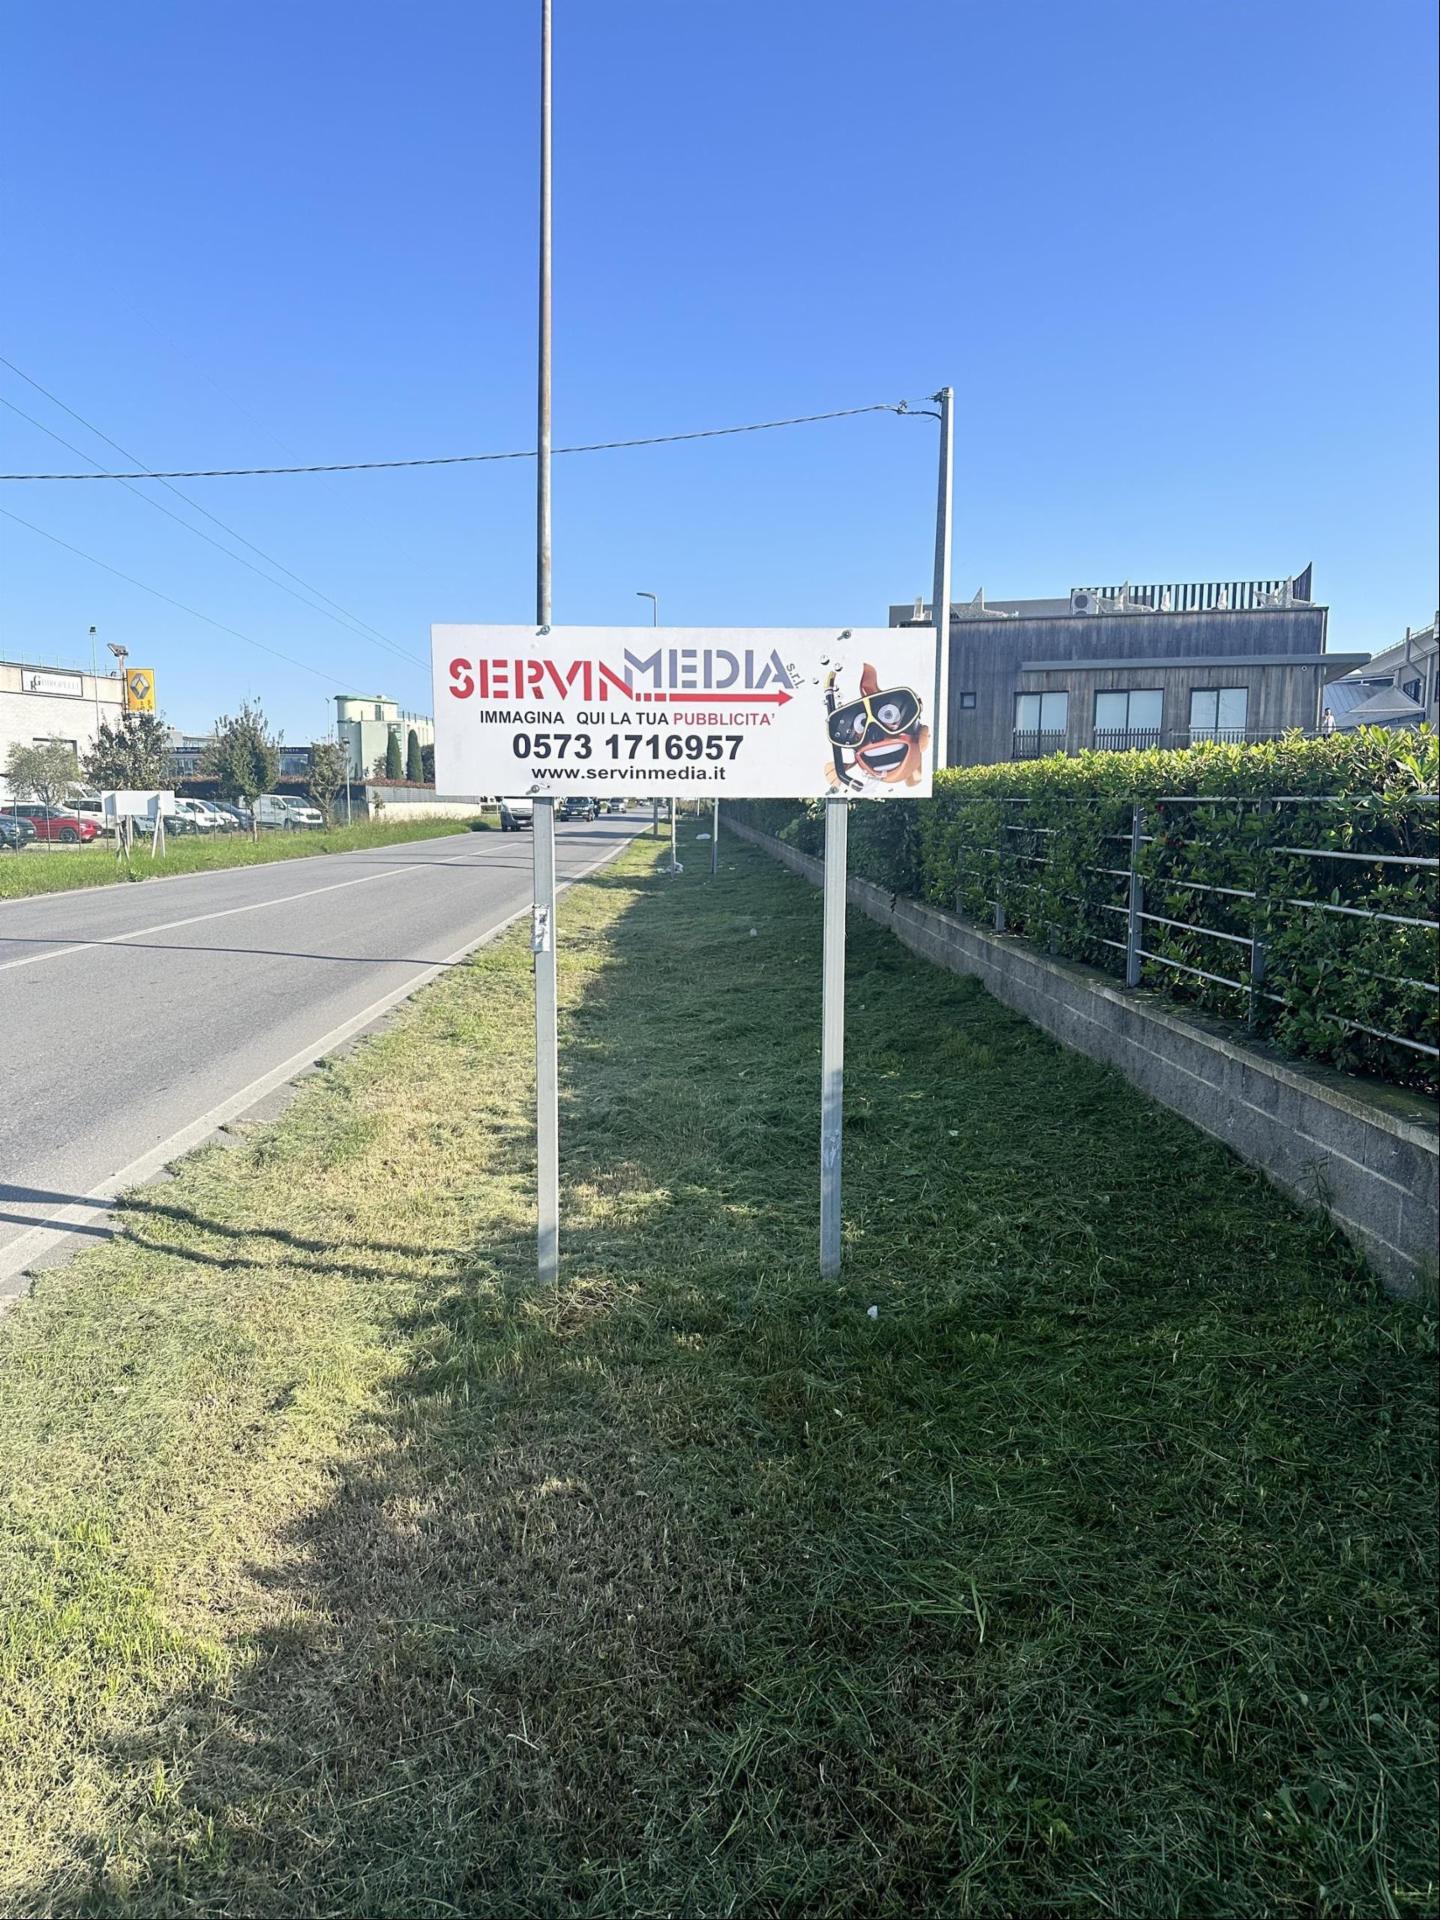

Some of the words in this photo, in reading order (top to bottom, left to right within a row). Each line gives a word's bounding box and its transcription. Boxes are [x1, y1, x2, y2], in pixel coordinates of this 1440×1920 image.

[480, 710, 565, 724] IMMAGINA
[576, 711, 605, 726] QUI
[610, 712, 632, 725] LA
[636, 712, 669, 726] TUA
[512, 733, 592, 759] 0573
[605, 734, 744, 760] 1716957
[531, 765, 726, 780] www.servinmedia.it
